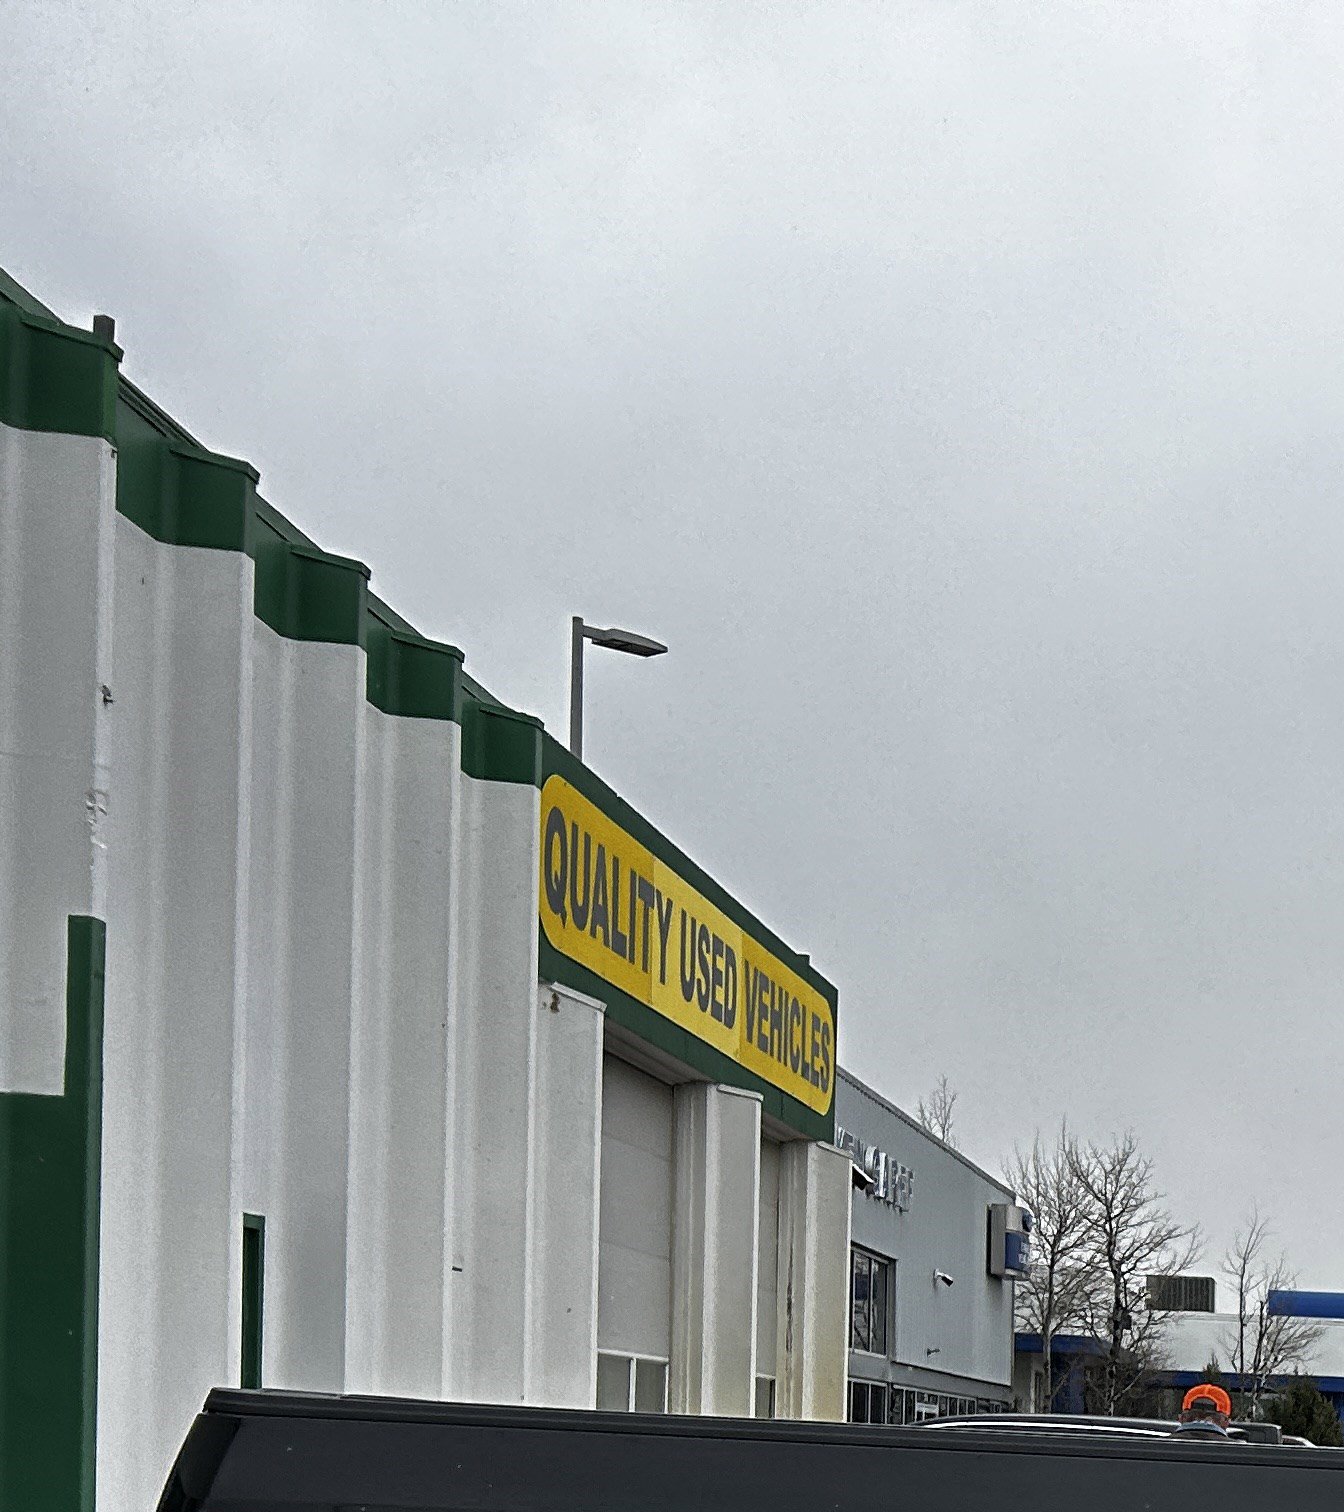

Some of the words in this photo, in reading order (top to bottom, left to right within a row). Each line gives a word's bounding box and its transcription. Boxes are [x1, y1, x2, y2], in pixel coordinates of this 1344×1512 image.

[544, 806, 673, 985] QUALITY
[680, 909, 738, 1030] USED
[743, 958, 831, 1094] VEHICLES
